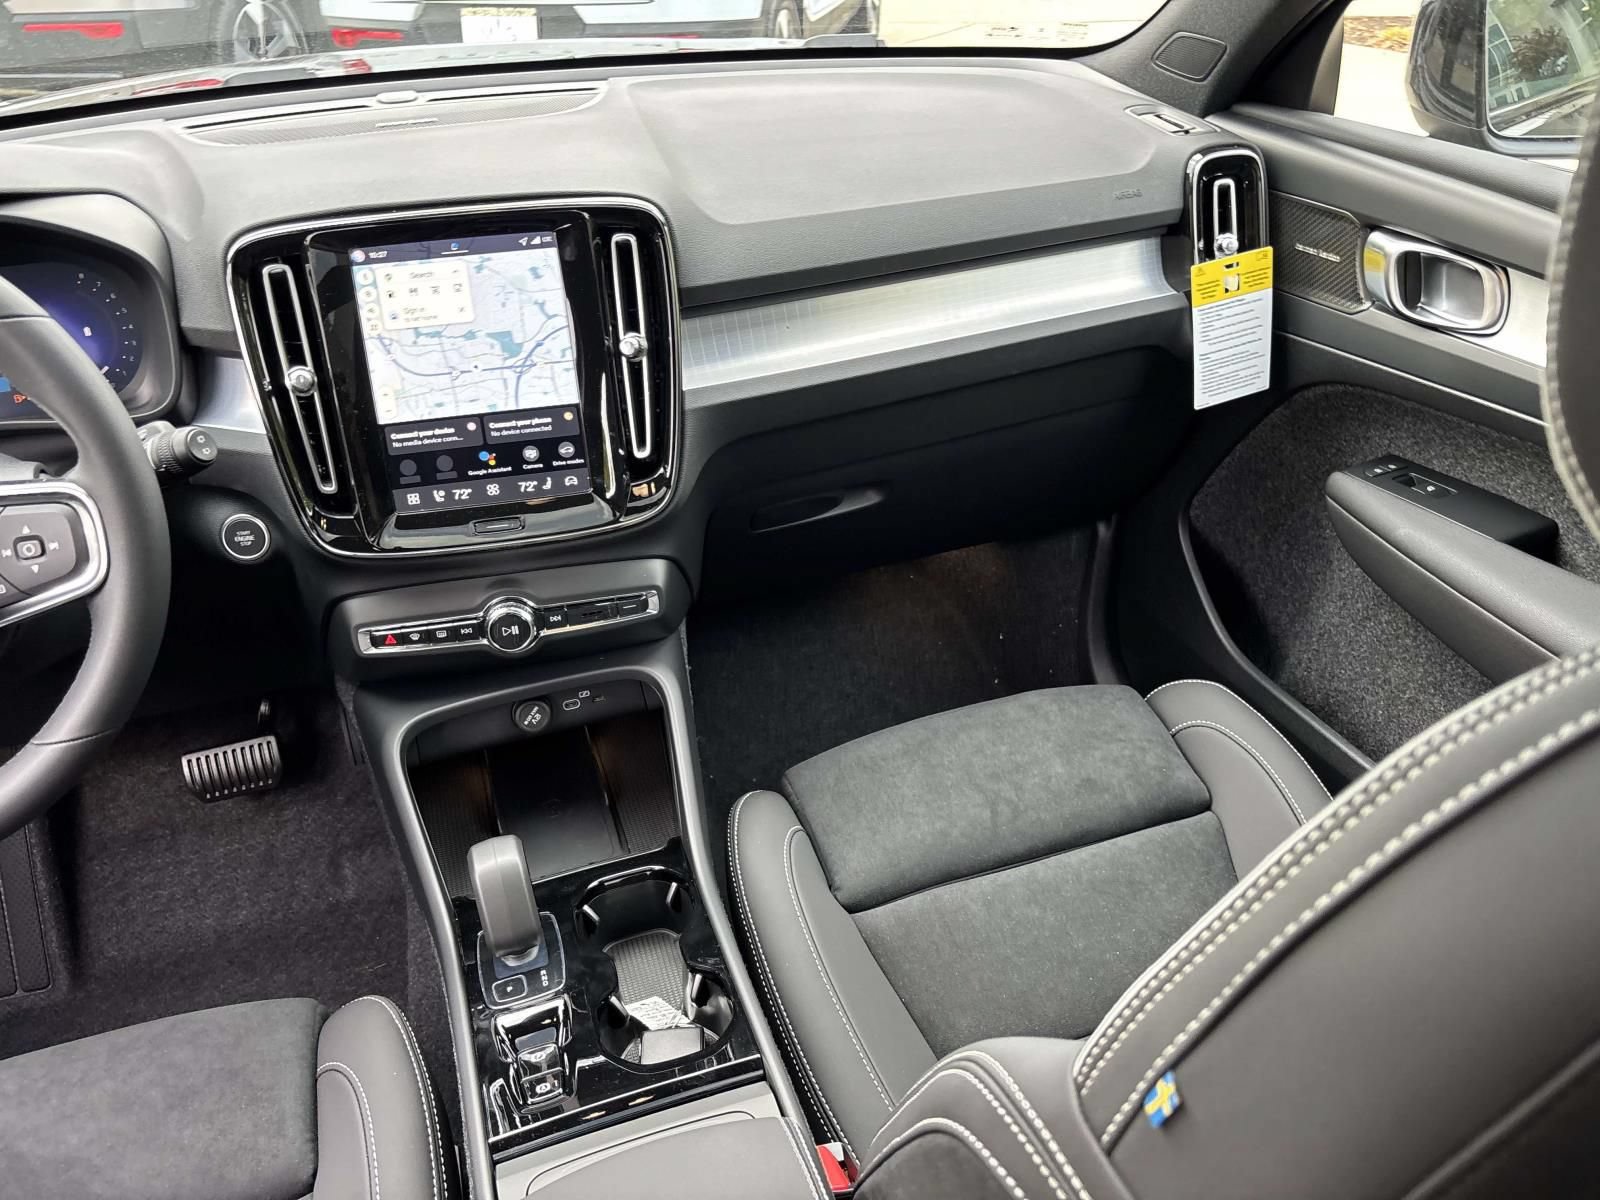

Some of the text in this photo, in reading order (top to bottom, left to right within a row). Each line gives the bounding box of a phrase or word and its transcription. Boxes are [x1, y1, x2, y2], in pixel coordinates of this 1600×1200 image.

[521, 424, 552, 434] connected
[423, 437, 442, 445] device
[488, 466, 512, 474] Assistant
[518, 481, 538, 492] 72°
[452, 488, 472, 499] 72°
